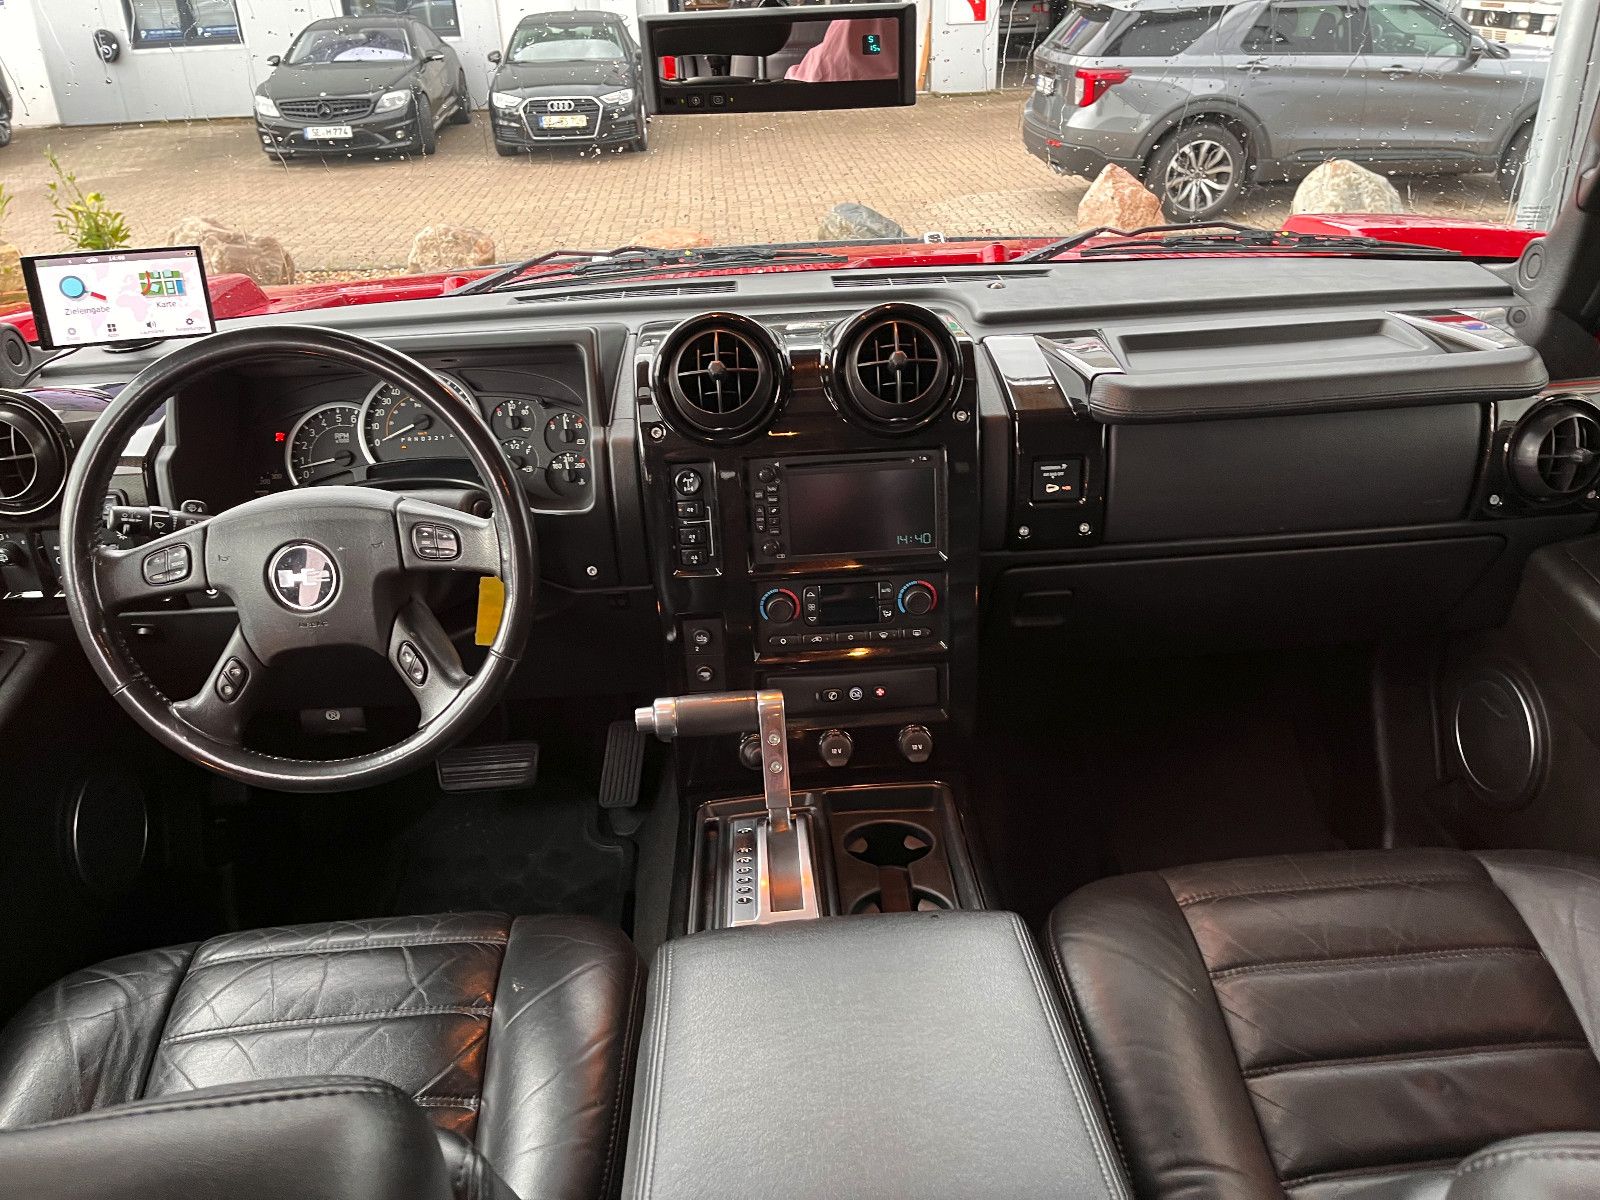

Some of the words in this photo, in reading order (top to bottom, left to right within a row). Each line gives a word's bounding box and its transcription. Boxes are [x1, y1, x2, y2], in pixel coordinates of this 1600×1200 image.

[156, 300, 177, 309] Karte
[64, 305, 111, 316] Zieleingabe
[391, 388, 401, 396] 40
[381, 397, 392, 405] 30
[375, 409, 385, 417] 20
[321, 418, 327, 427] 4
[336, 414, 342, 423] 5
[350, 415, 357, 423] 6
[309, 428, 316, 437] 3
[301, 441, 308, 450] 2
[374, 439, 380, 447] 0
[896, 532, 932, 545] 14:40
